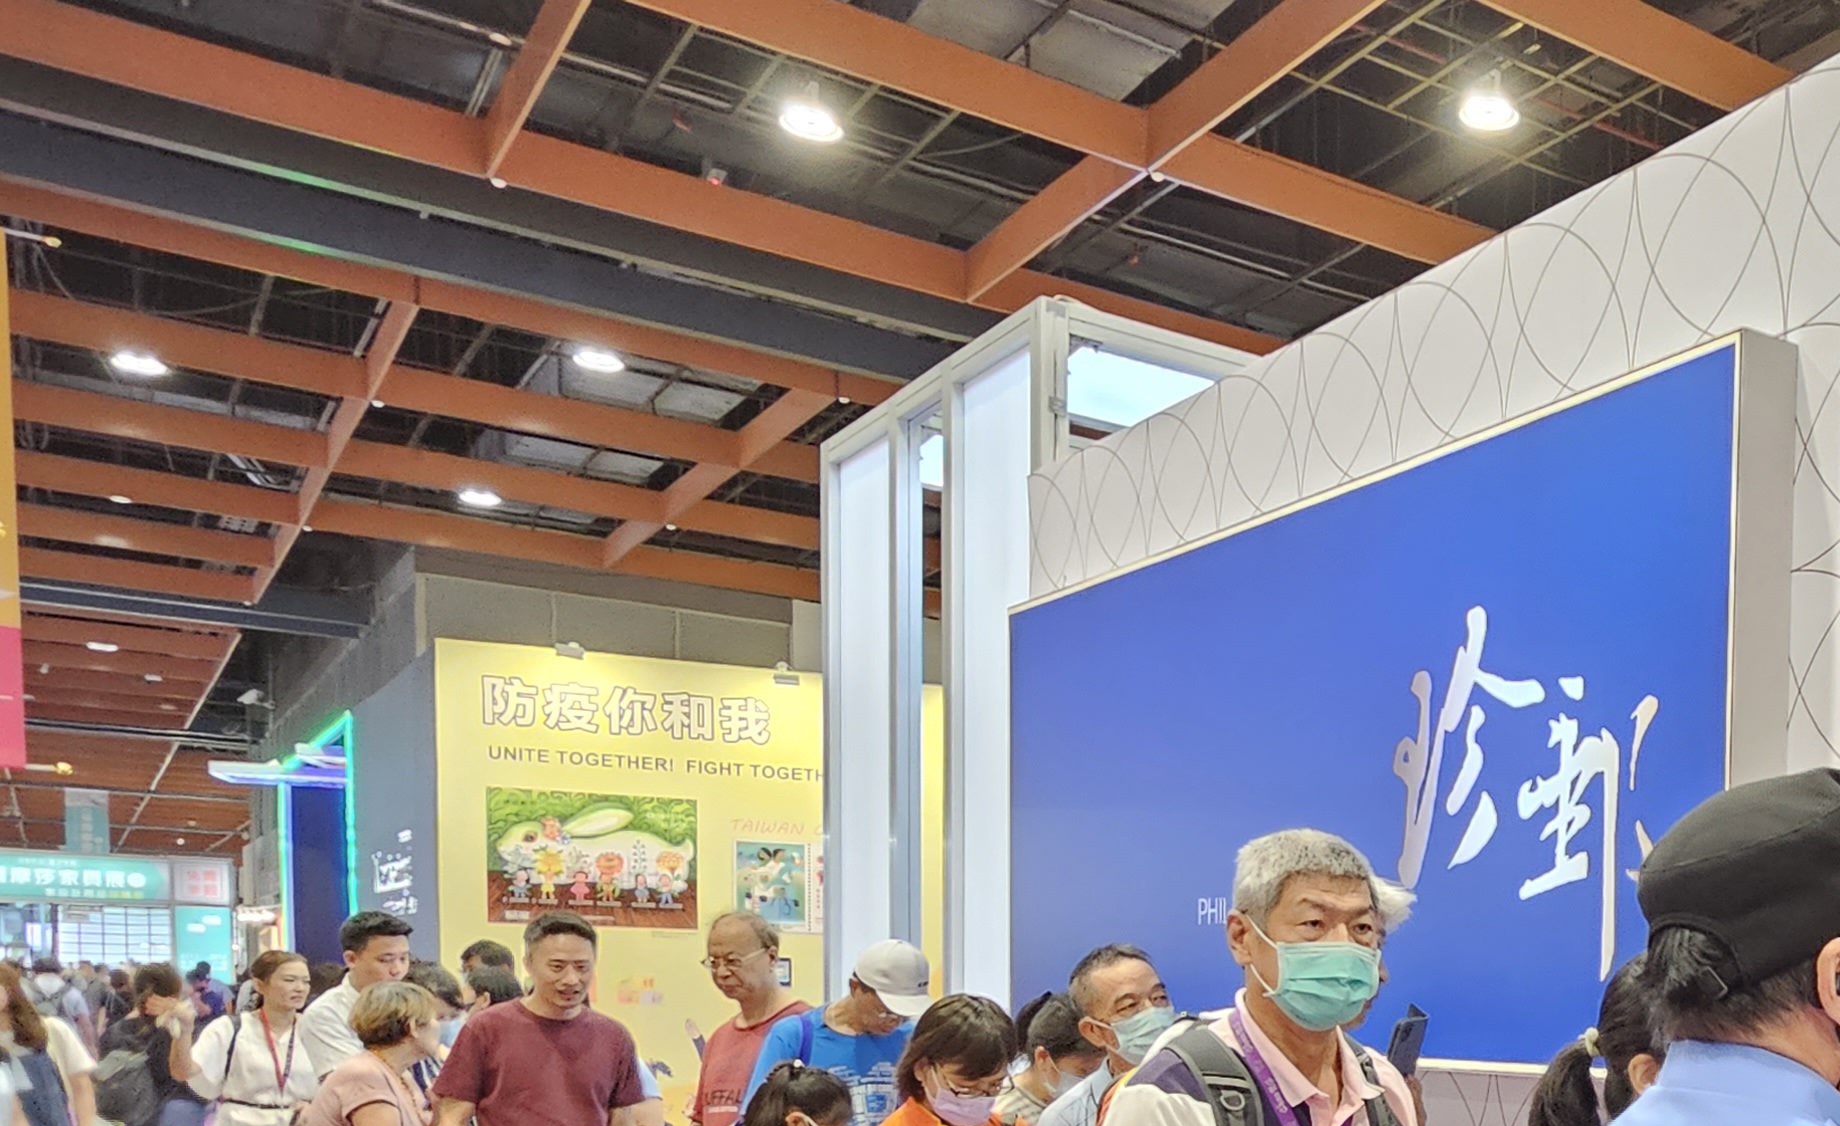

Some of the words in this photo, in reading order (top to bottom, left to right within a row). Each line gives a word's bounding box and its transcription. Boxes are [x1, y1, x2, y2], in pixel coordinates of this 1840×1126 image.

[481, 675, 771, 745] 防疫你和我
[488, 745, 550, 764] UNITE
[556, 750, 674, 772] TOGETHER!
[686, 760, 744, 778] FIGHT
[749, 763, 823, 782] TOGETH
[731, 819, 805, 835] TAIWAN
[1198, 897, 1227, 925] PHIL
